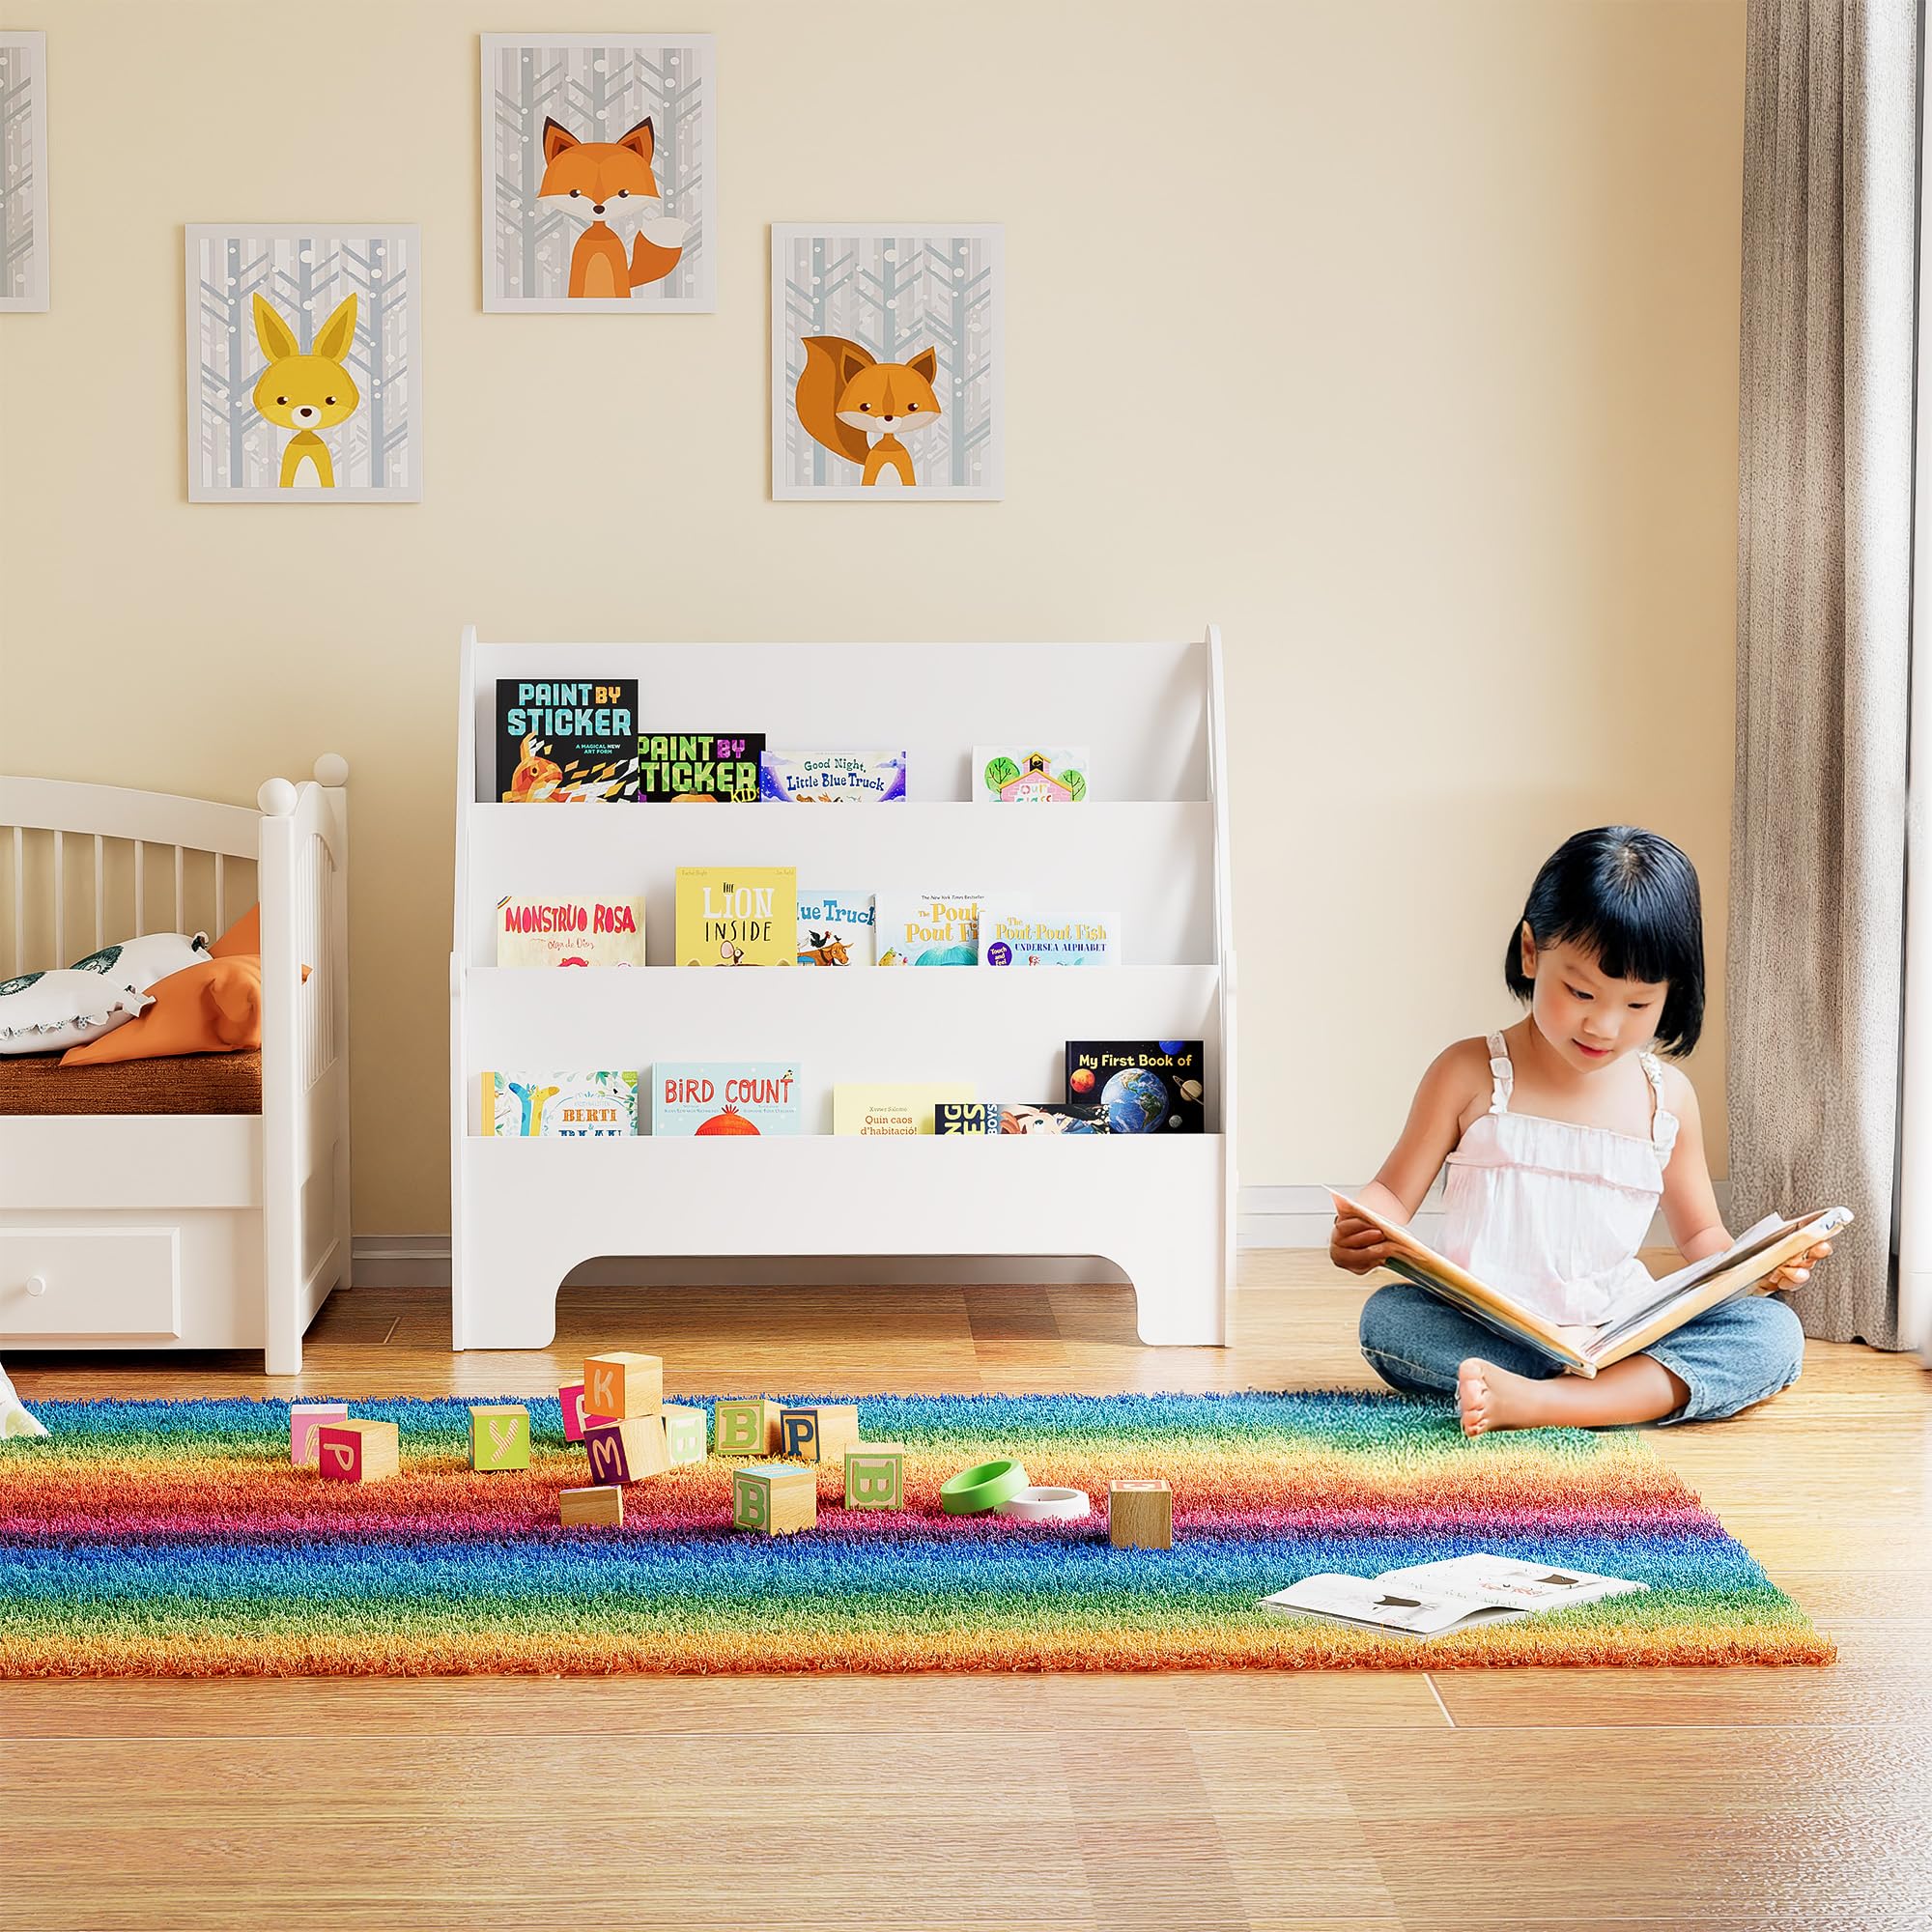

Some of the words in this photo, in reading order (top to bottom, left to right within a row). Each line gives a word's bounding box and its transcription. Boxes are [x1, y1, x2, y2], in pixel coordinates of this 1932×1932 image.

[519, 683, 592, 706] PAINT
[595, 686, 621, 704] BY
[507, 708, 632, 736] STICKER
[638, 736, 715, 761] PAINT
[717, 739, 746, 759] BY
[638, 762, 757, 792] TICKER
[804, 759, 831, 772] Good
[835, 757, 867, 773] Night,
[786, 774, 819, 791] Little
[821, 773, 847, 788] Blue
[848, 772, 885, 791] Truck
[703, 887, 775, 920] LION
[796, 901, 822, 921] ue
[505, 903, 588, 934] MONSTRUO
[593, 903, 637, 934] ROSA
[1007, 917, 1023, 926] The
[705, 921, 773, 942] INSIDE
[904, 921, 954, 943] Pout
[959, 922, 979, 943] Fi
[1074, 923, 1107, 941] Fish
[1014, 943, 1059, 952] UNDERSEA
[1062, 943, 1107, 952] ALPHABET
[1079, 1054, 1098, 1069] My
[1101, 1054, 1135, 1066] First
[1139, 1054, 1174, 1066] Book
[1177, 1054, 1192, 1066] of
[724, 1078, 794, 1103] COUNT
[562, 1108, 617, 1122] BERTI
[865, 1115, 890, 1125] Quin
[987, 1103, 998, 1135] BOYS
[593, 1369, 614, 1409] K
[721, 1407, 758, 1449] B
[785, 1418, 814, 1457] P
[324, 1443, 355, 1472] P
[592, 1435, 622, 1479] M
[851, 1460, 895, 1503] B
[737, 1480, 765, 1527] B
